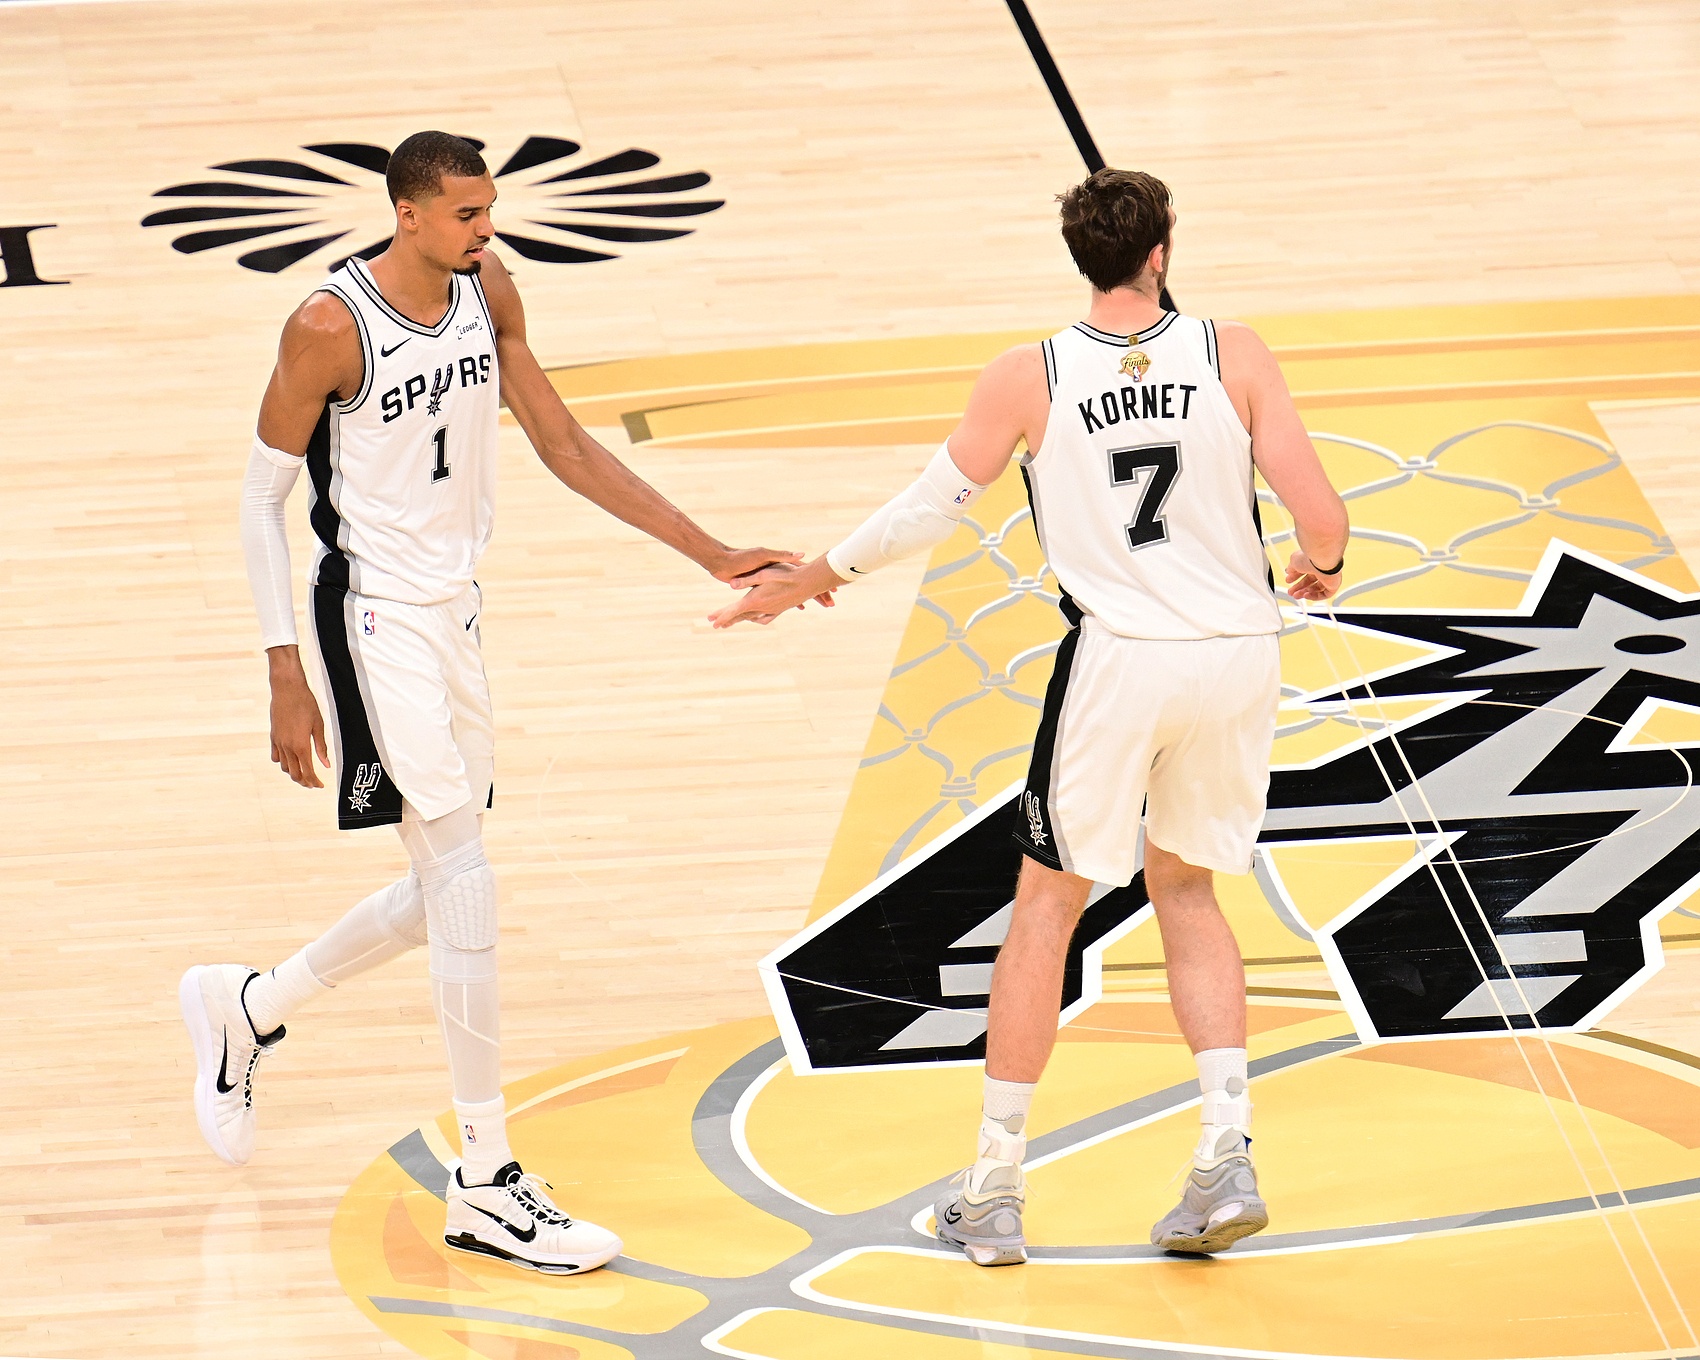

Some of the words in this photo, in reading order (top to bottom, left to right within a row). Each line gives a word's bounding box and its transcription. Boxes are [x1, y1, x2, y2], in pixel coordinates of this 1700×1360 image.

[459, 320, 479, 336] LEDGER
[380, 354, 491, 424] SPURS
[1119, 354, 1150, 373] Finals
[1077, 383, 1197, 435] KORNET
[431, 424, 451, 484] 1
[1106, 440, 1184, 552] 7
